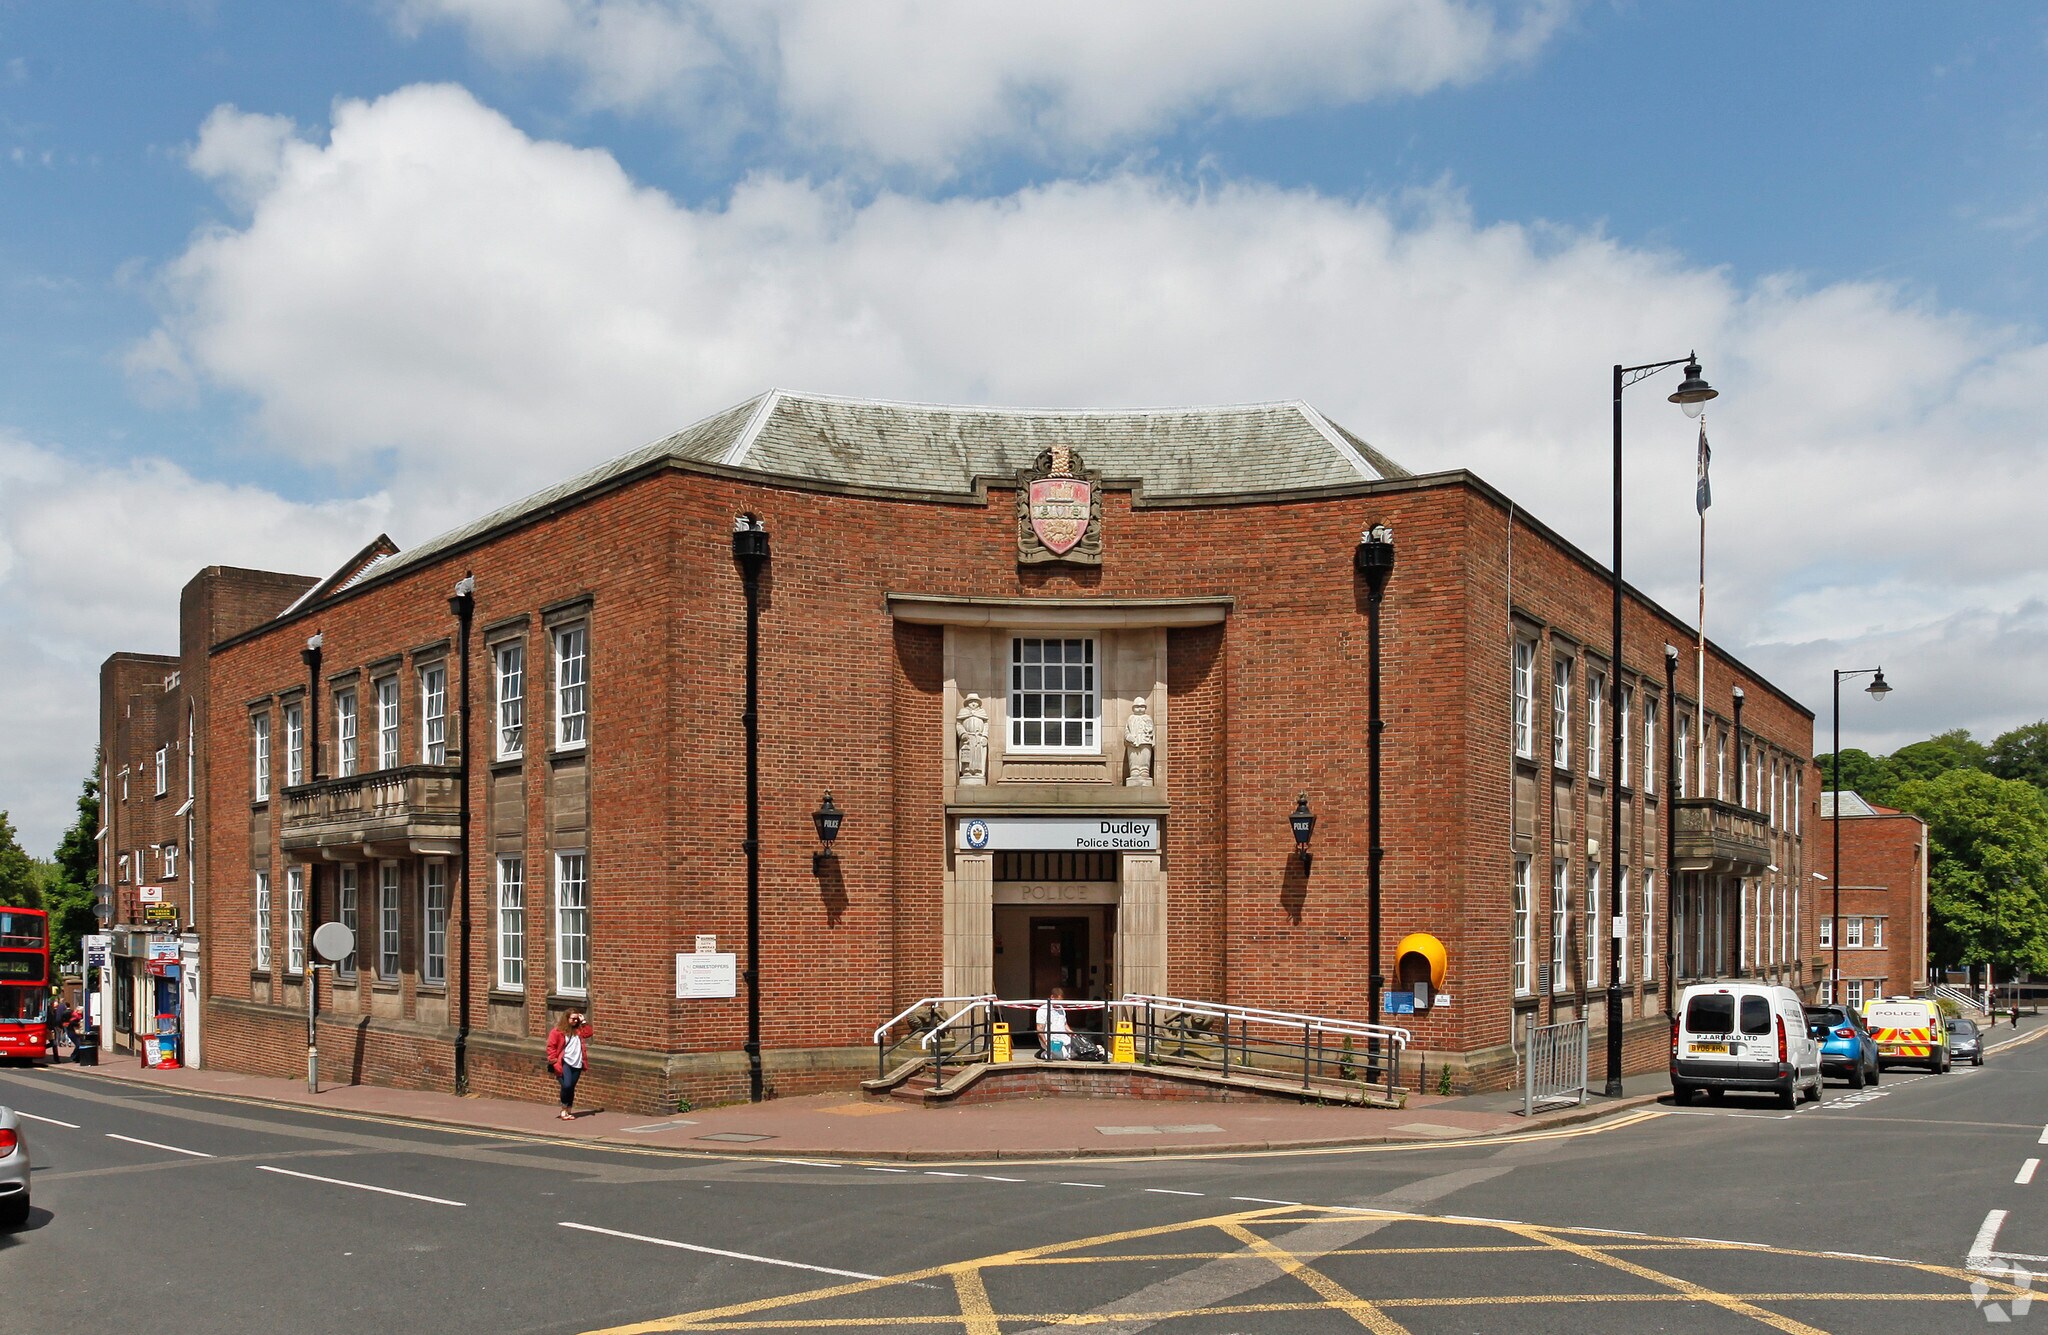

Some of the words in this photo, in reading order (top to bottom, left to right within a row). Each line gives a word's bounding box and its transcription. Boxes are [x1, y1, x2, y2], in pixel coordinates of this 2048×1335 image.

[824, 819, 839, 829] POLICE
[1100, 821, 1150, 837] Dudley
[1293, 822, 1309, 831] POLICE
[1076, 838, 1109, 847] Police
[1112, 838, 1150, 847] Station
[1022, 885, 1088, 900] POLICE
